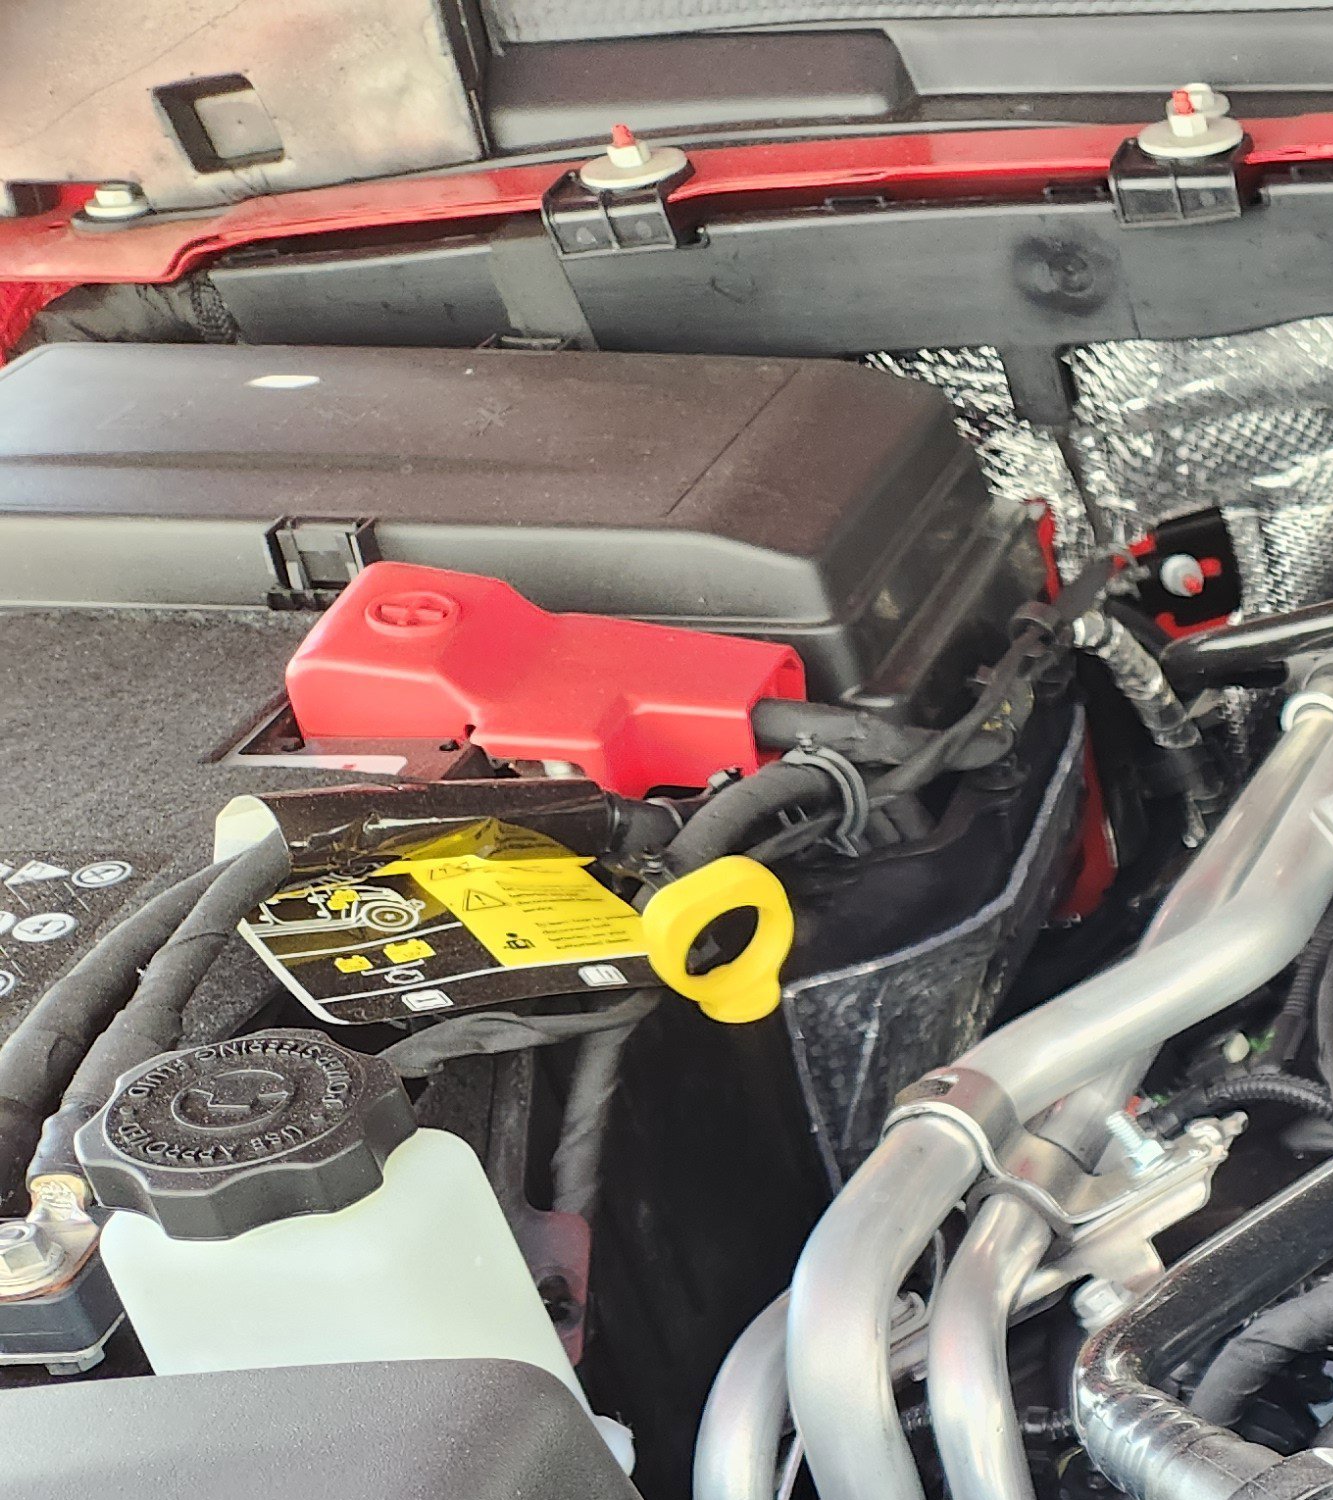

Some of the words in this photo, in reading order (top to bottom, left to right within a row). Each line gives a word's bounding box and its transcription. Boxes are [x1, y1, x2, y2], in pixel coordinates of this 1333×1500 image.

[195, 1039, 320, 1062] STEERING
[128, 1058, 187, 1099] FLUID
[118, 1122, 235, 1161] APPROVED
[250, 1123, 304, 1151] USE
